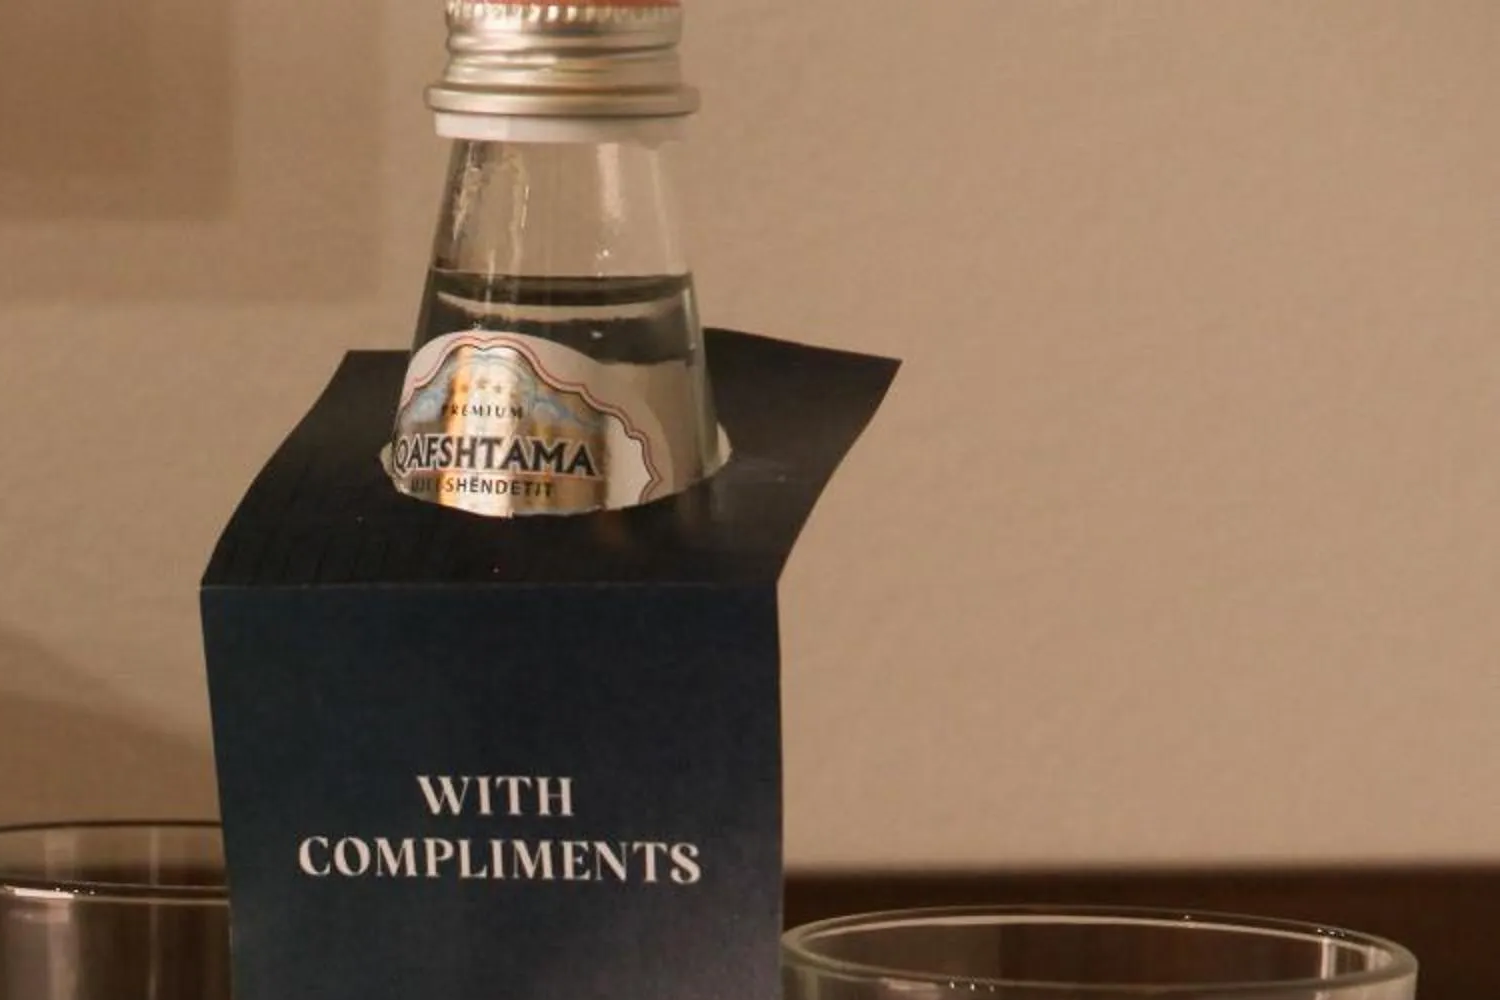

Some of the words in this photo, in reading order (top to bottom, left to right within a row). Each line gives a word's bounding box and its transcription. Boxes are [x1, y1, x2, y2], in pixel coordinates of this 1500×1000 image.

[441, 403, 524, 419] PREMIUM
[394, 433, 596, 477] QAFSHTAMA
[417, 775, 575, 817] WITH
[298, 836, 701, 884] COMPLIMENTS
